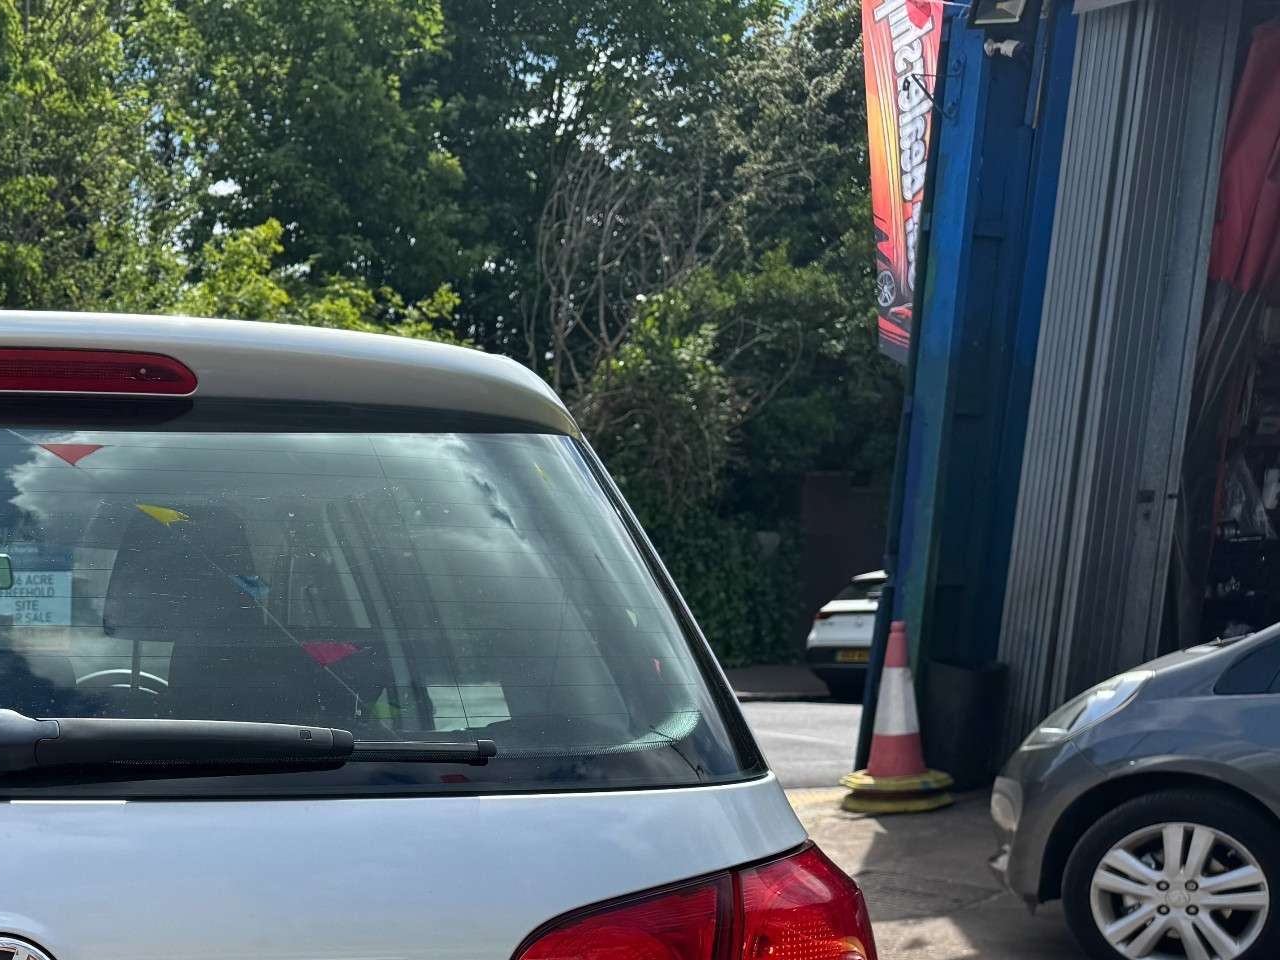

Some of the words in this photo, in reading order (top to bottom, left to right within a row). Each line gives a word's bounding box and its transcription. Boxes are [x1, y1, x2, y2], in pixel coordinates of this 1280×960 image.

[25, 575, 54, 585] ACRE
[15, 600, 40, 611] SITE
[25, 612, 52, 623] SALE
